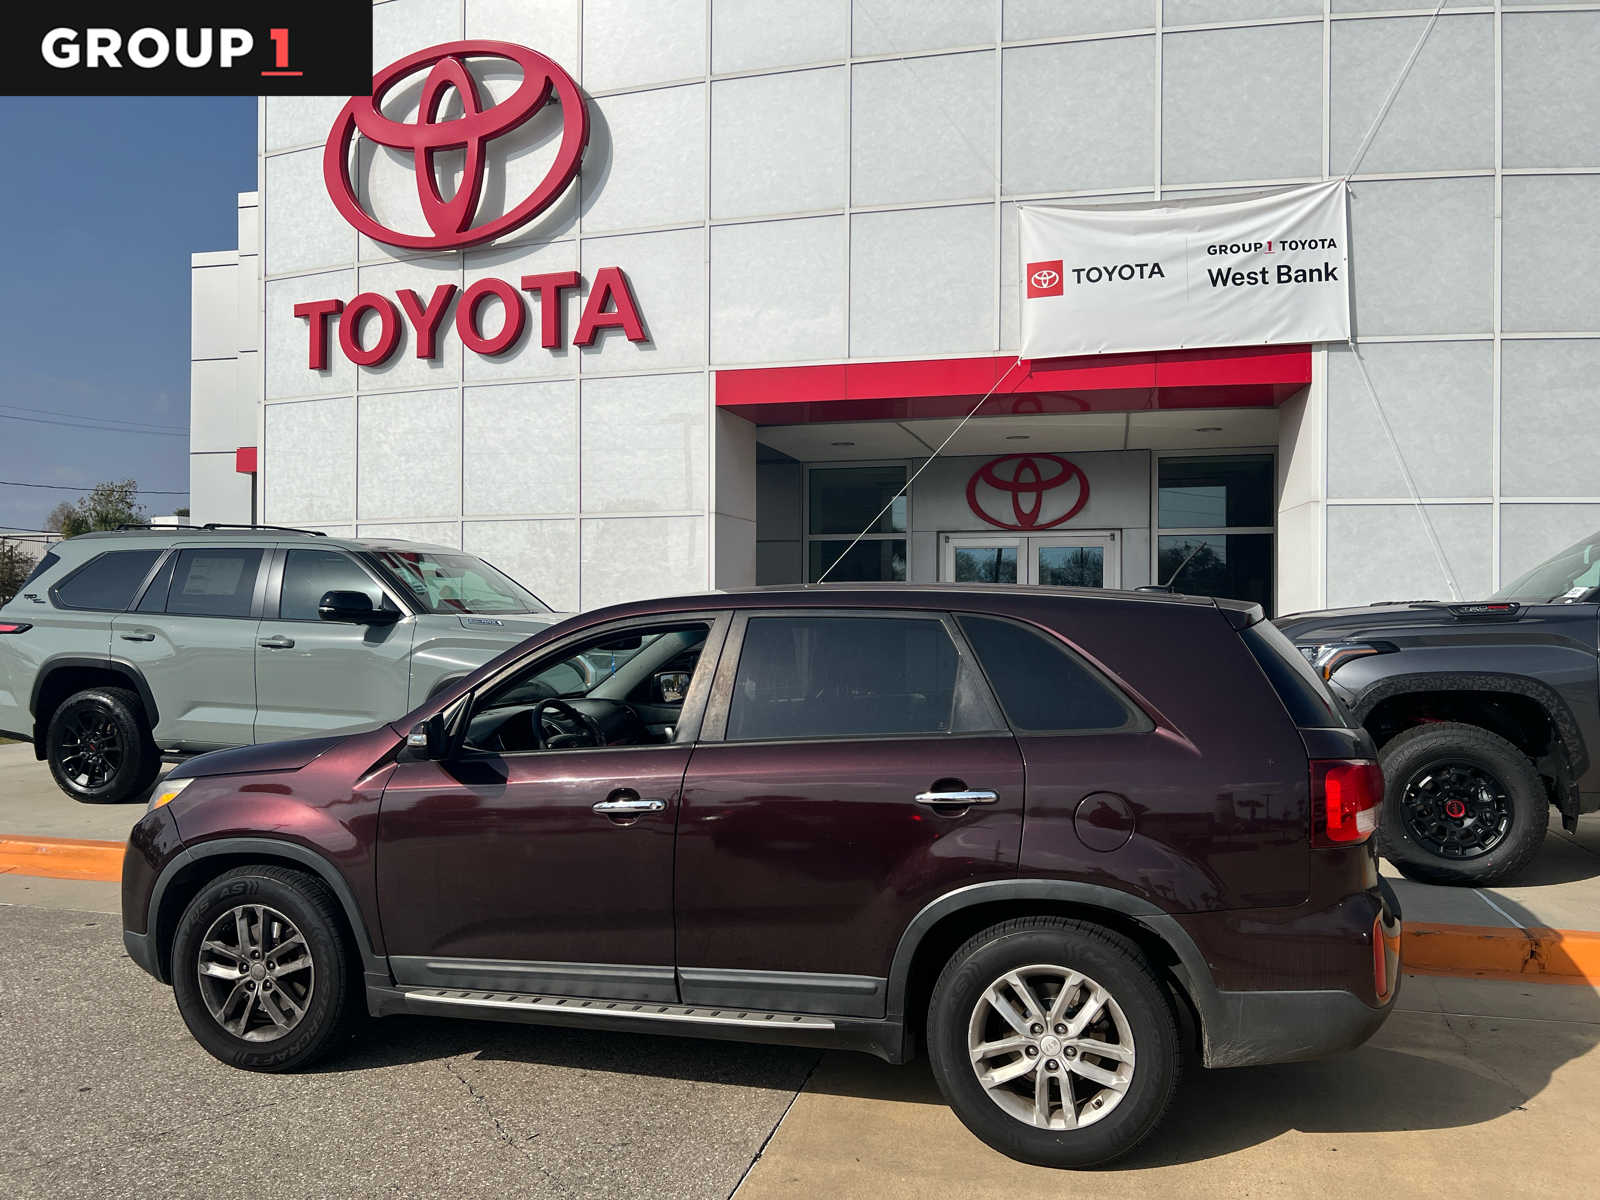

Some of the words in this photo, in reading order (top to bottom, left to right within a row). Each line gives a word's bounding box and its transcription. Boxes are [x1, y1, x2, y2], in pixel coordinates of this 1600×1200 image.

[1207, 242, 1263, 256] GROUP
[1280, 238, 1338, 252] TOYOTA
[1072, 262, 1166, 285] TOYOTA
[1208, 266, 1270, 288] West
[1276, 262, 1339, 285] Bank
[294, 266, 647, 370] TOYOTA
